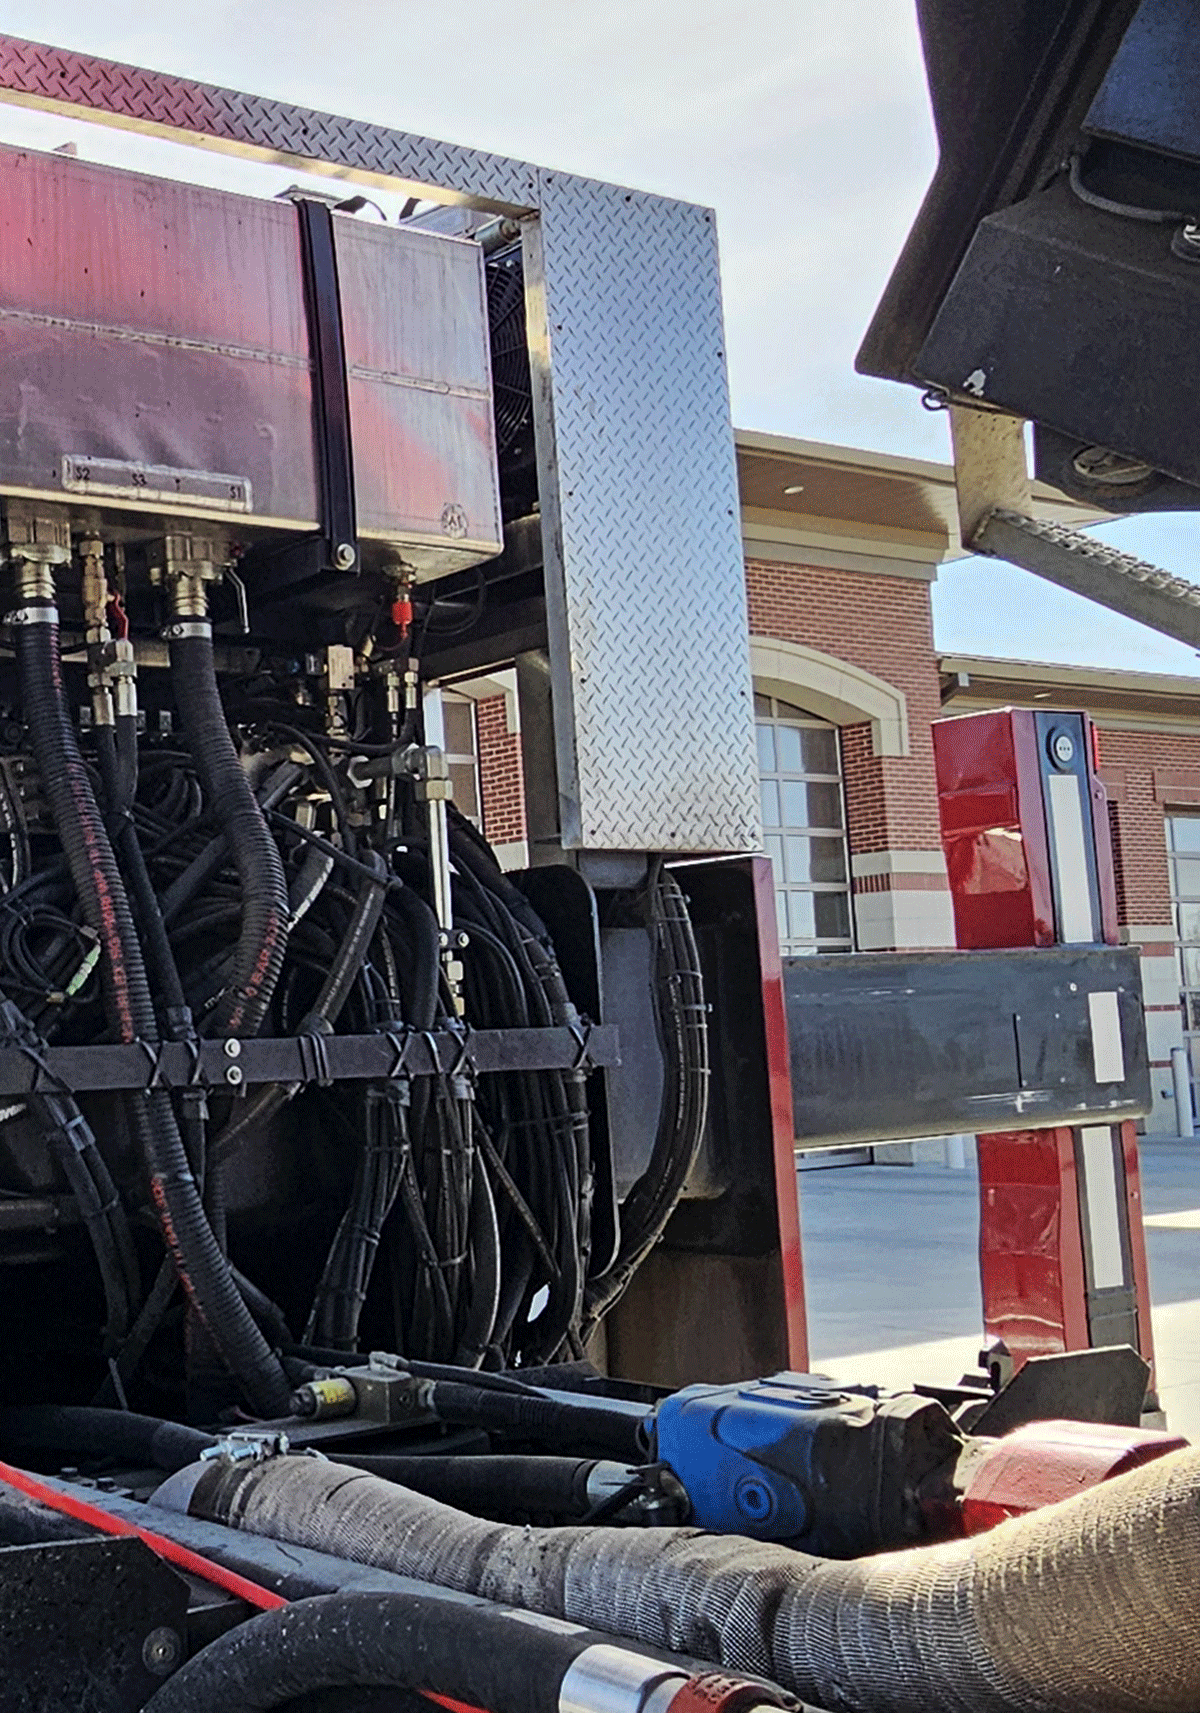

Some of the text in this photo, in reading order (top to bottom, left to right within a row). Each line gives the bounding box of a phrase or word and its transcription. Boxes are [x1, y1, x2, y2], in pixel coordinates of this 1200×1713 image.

[75, 466, 91, 481] S2
[132, 473, 148, 487] S3
[228, 485, 242, 499] S1
